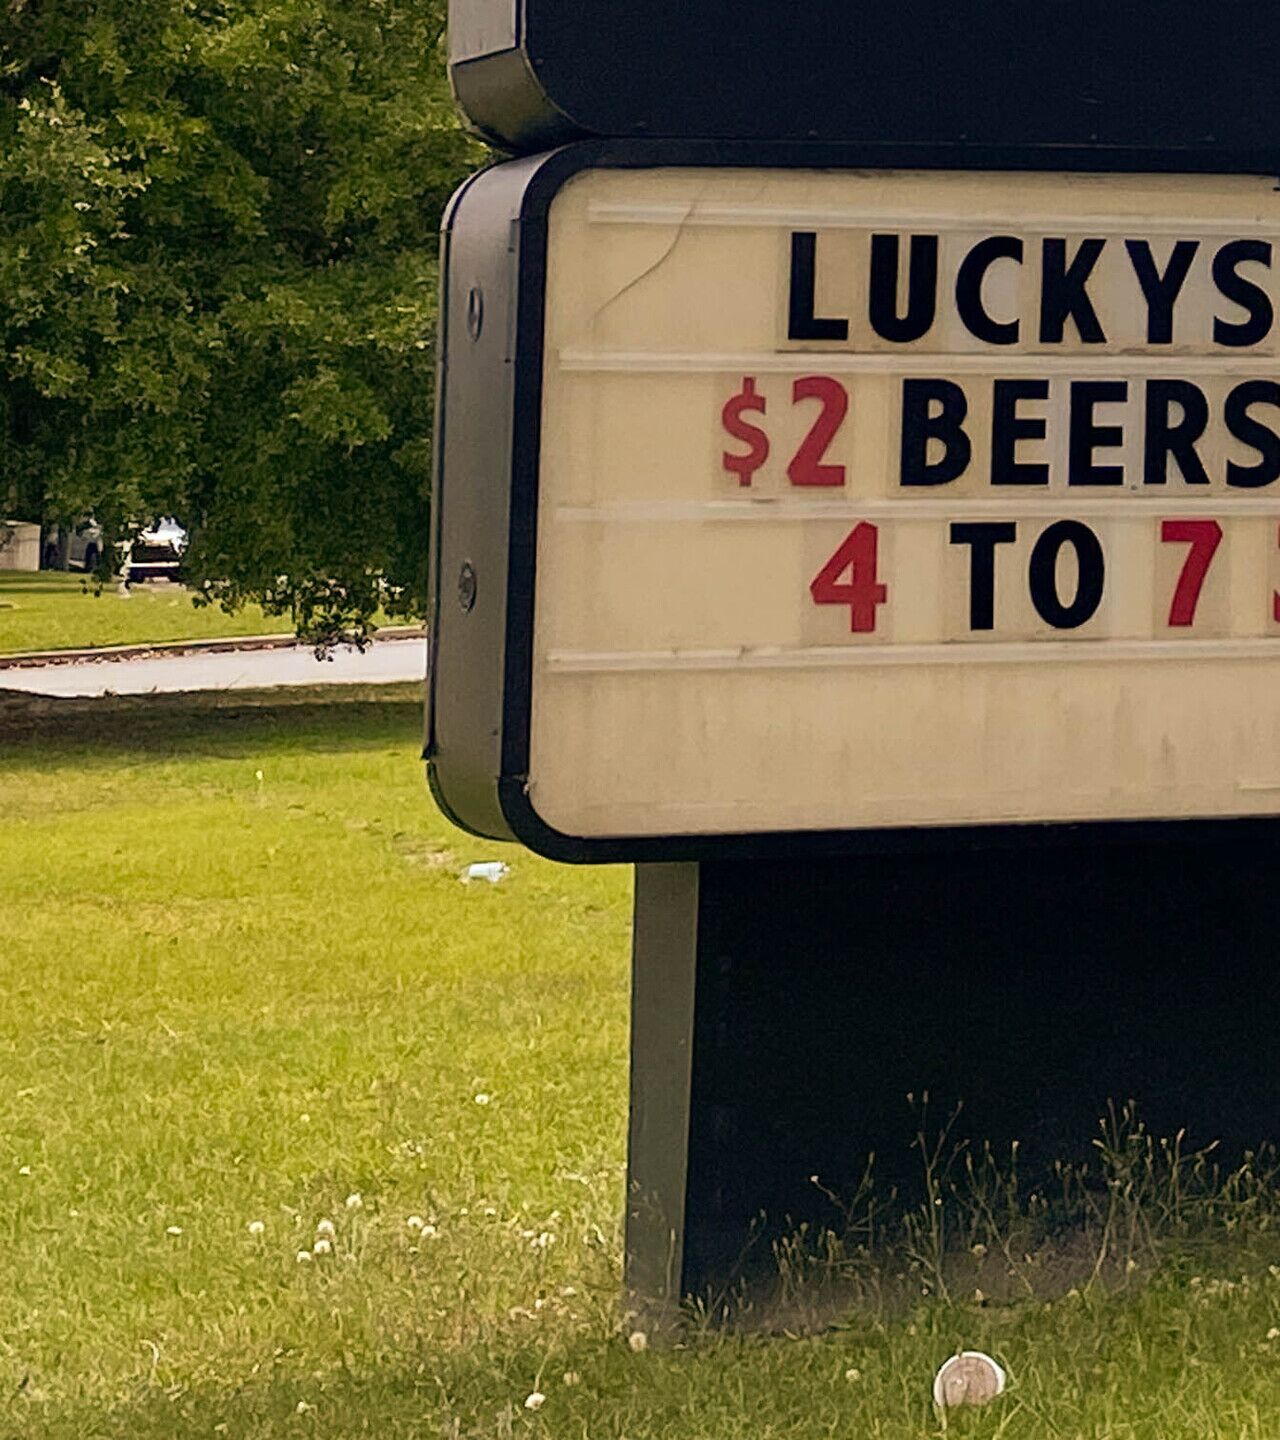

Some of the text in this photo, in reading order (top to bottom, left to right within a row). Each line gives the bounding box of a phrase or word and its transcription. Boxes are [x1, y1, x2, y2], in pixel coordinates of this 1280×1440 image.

[787, 230, 1274, 348] LUCKYS
[720, 374, 849, 487] $2
[809, 520, 888, 634] 4
[949, 519, 1106, 632] TO
[1160, 517, 1223, 628] 7
